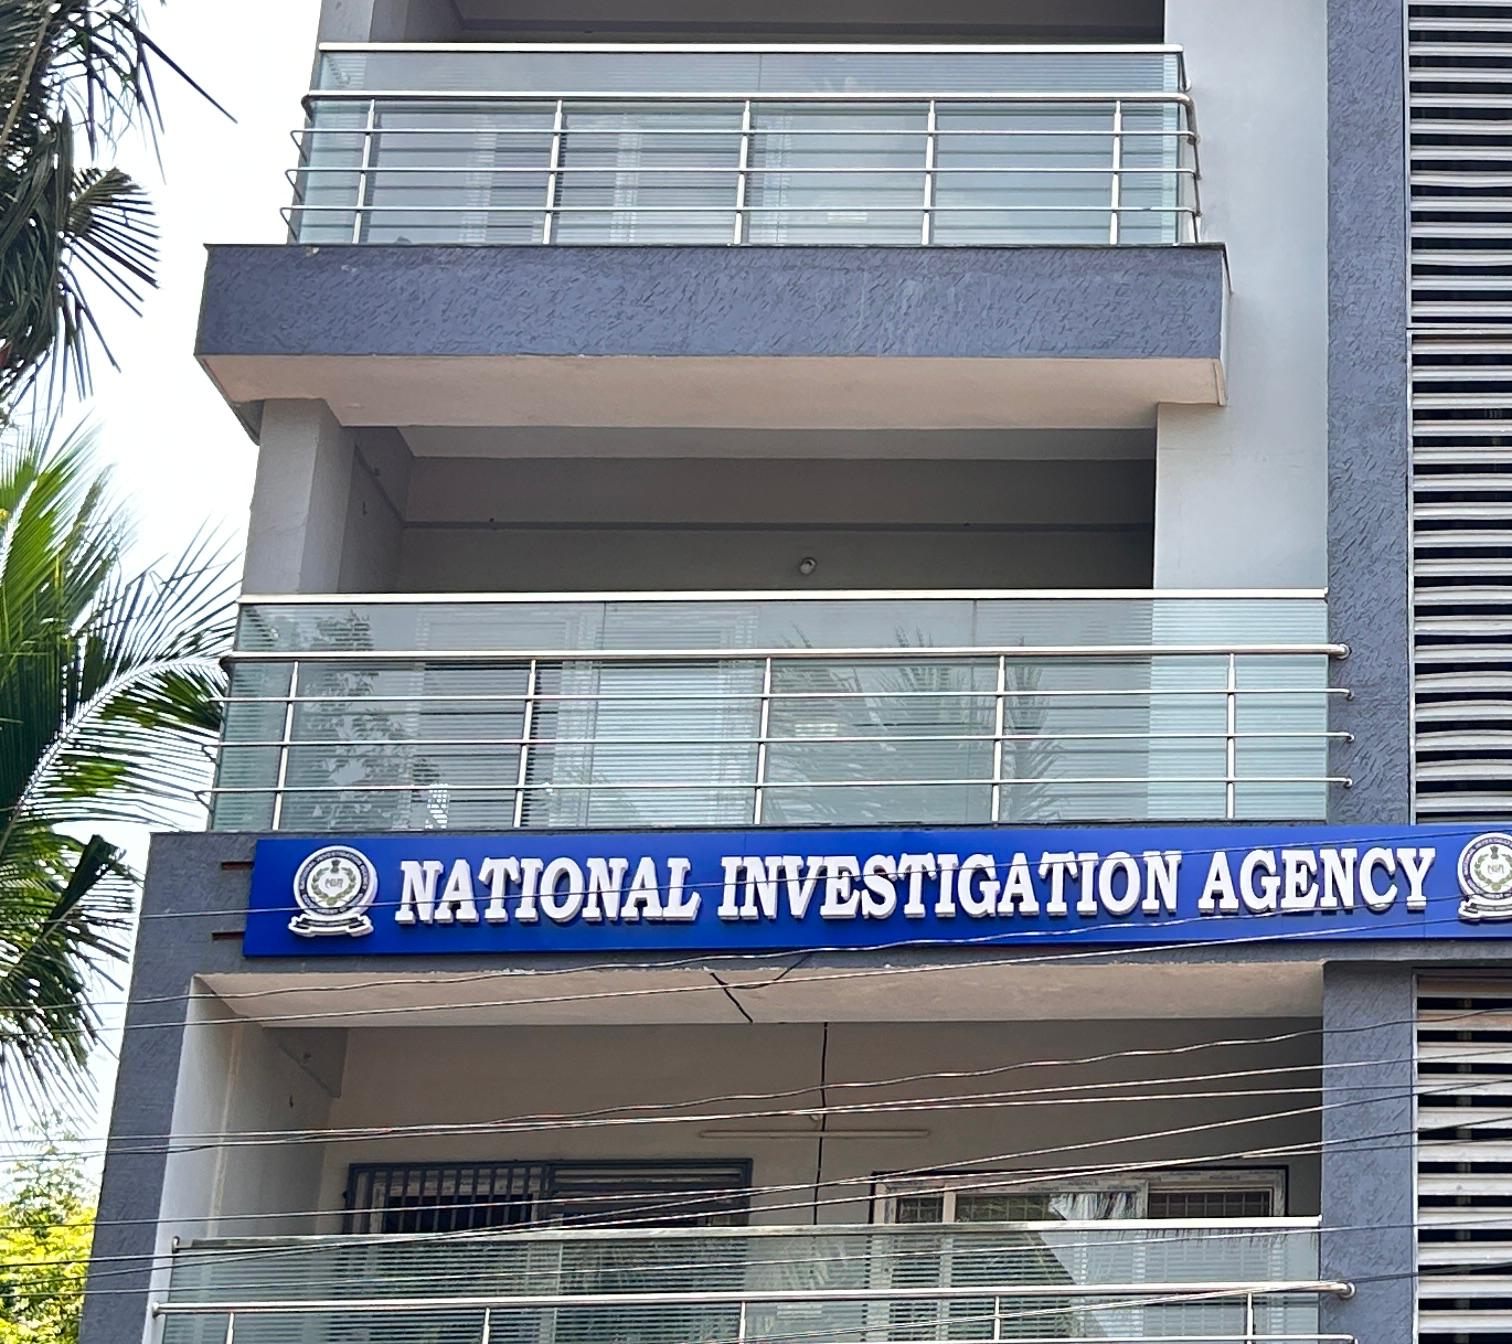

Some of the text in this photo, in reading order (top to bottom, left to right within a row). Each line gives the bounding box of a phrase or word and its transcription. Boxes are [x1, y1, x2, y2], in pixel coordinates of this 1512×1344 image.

[395, 855, 702, 924] NATIONAL
[718, 850, 1182, 921] INVESTIGATION
[1198, 847, 1436, 914] AGENCY
